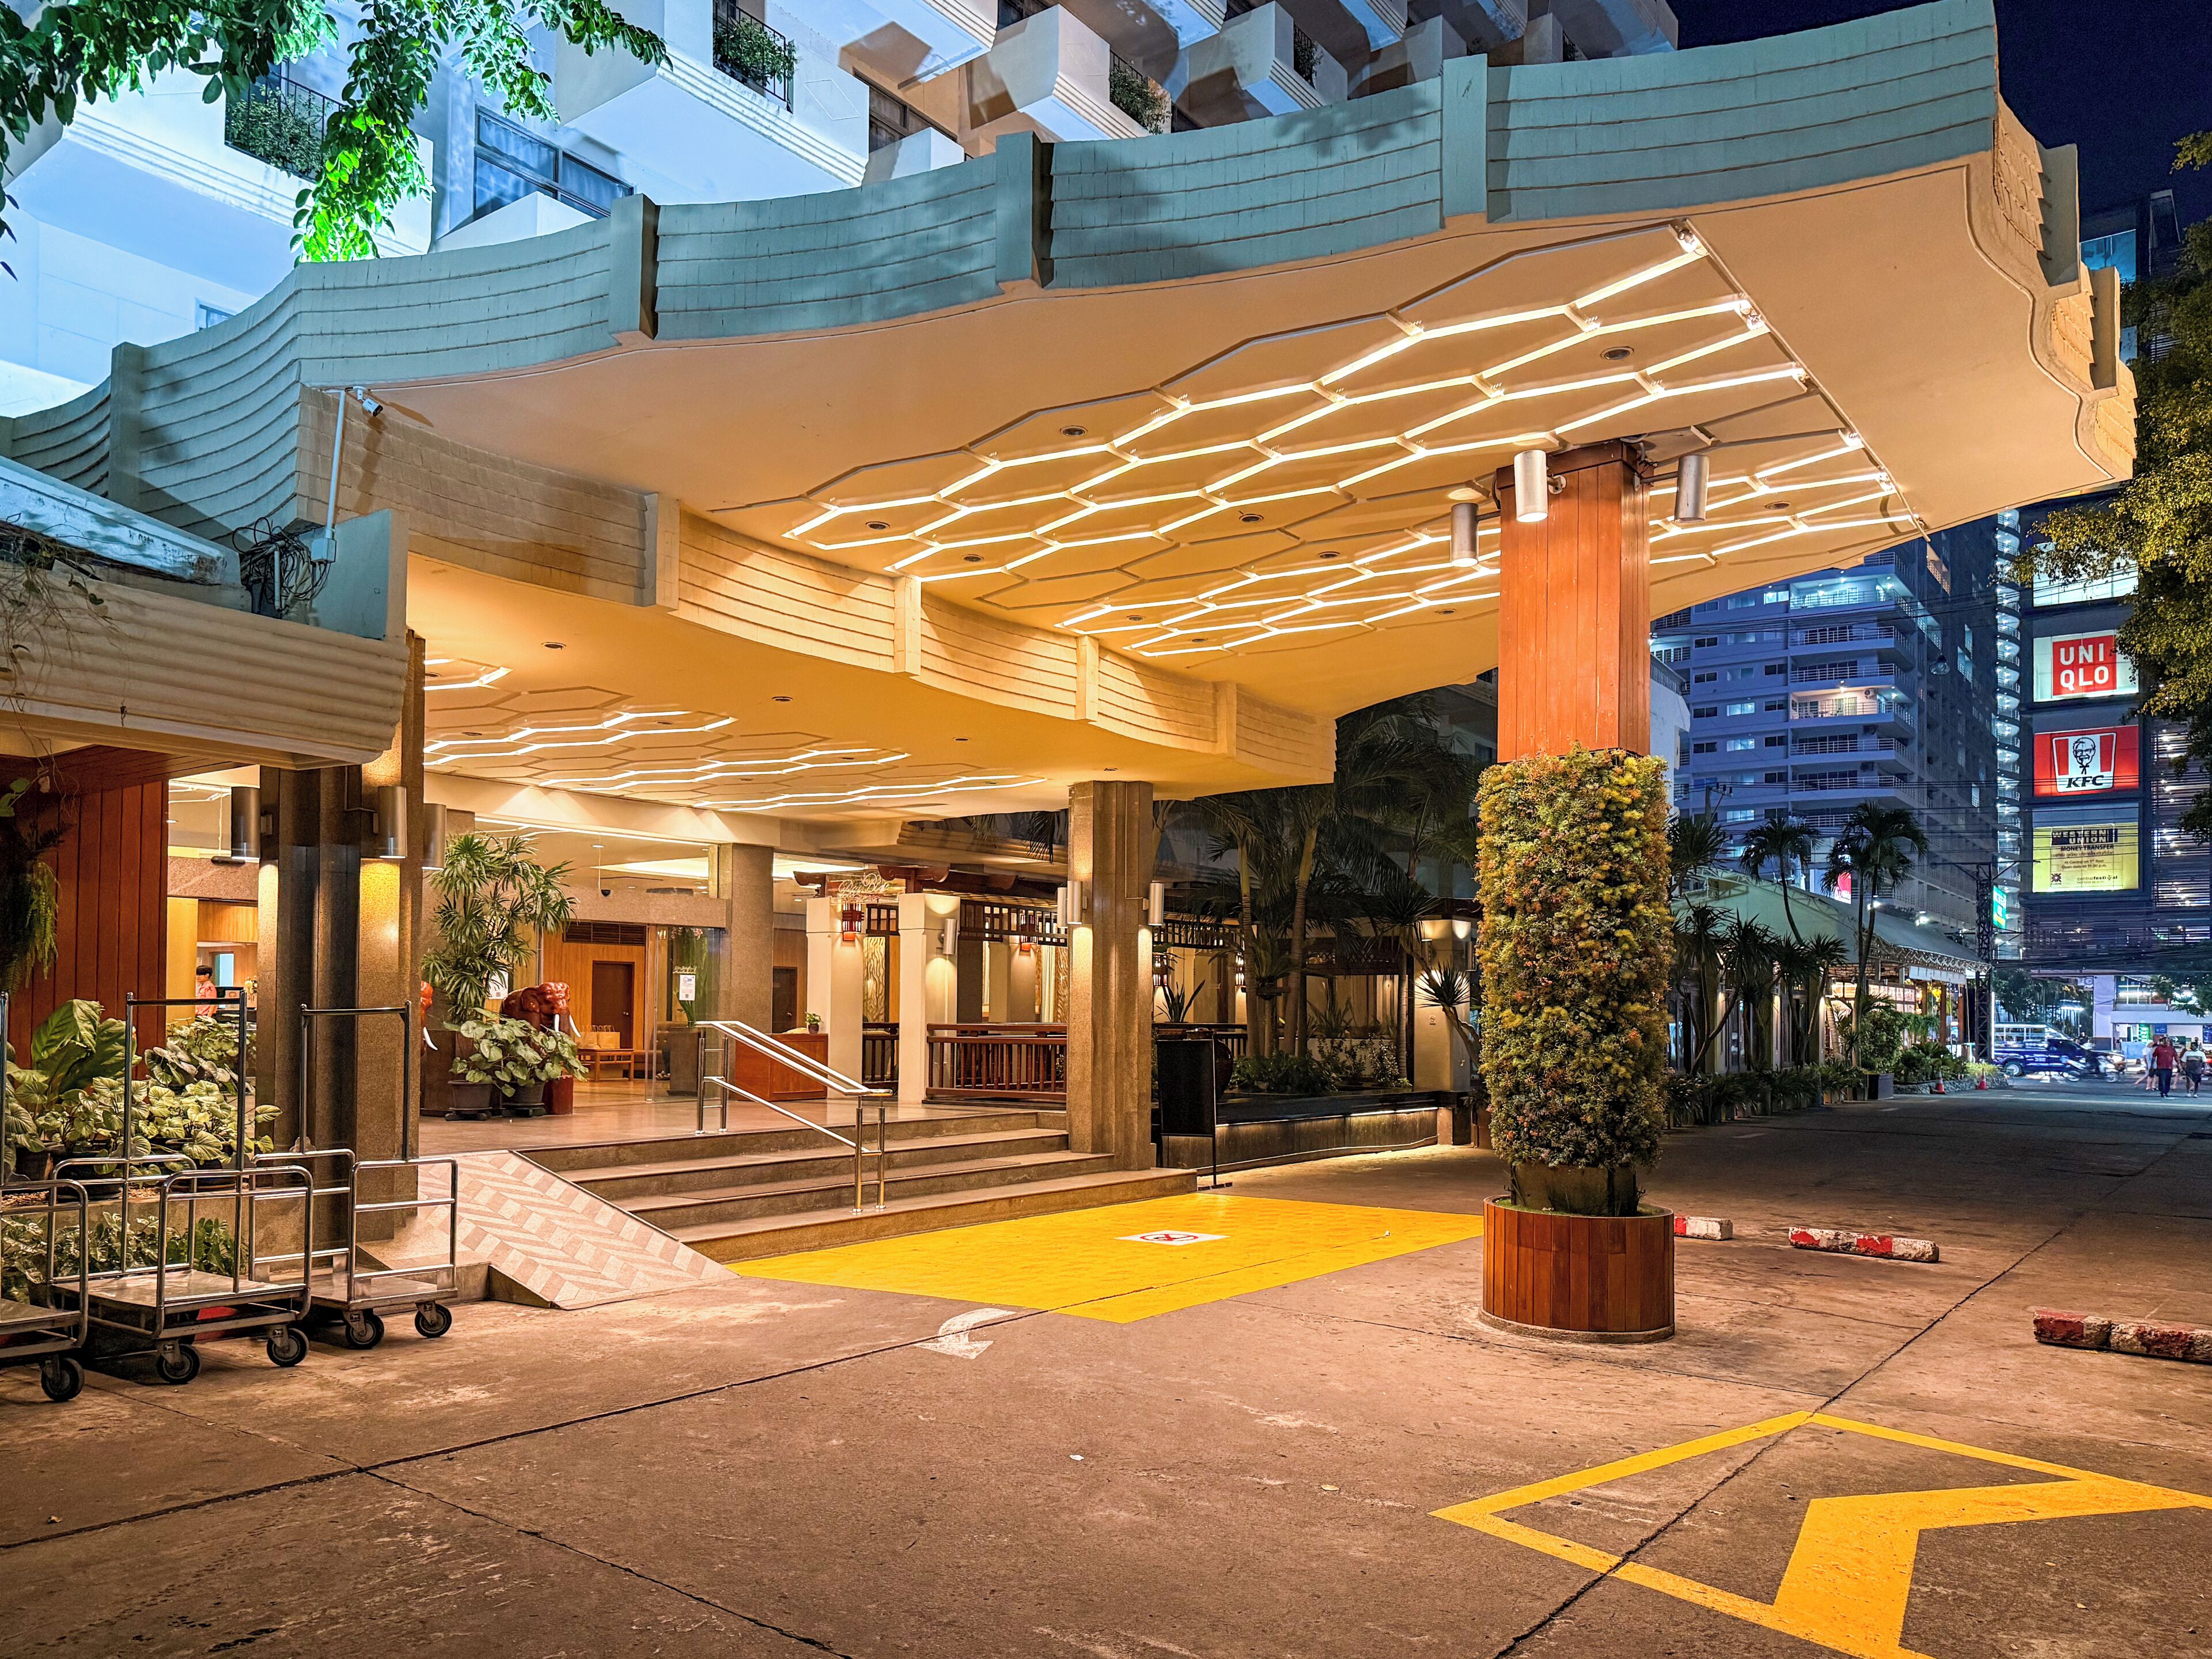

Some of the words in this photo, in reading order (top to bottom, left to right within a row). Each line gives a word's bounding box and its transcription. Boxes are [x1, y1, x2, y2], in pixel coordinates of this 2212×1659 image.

[2060, 643, 2104, 665] UNI
[2060, 666, 2109, 690] QLO
[2066, 775, 2104, 789] KFC
[2052, 830, 2107, 838] WESTERN
